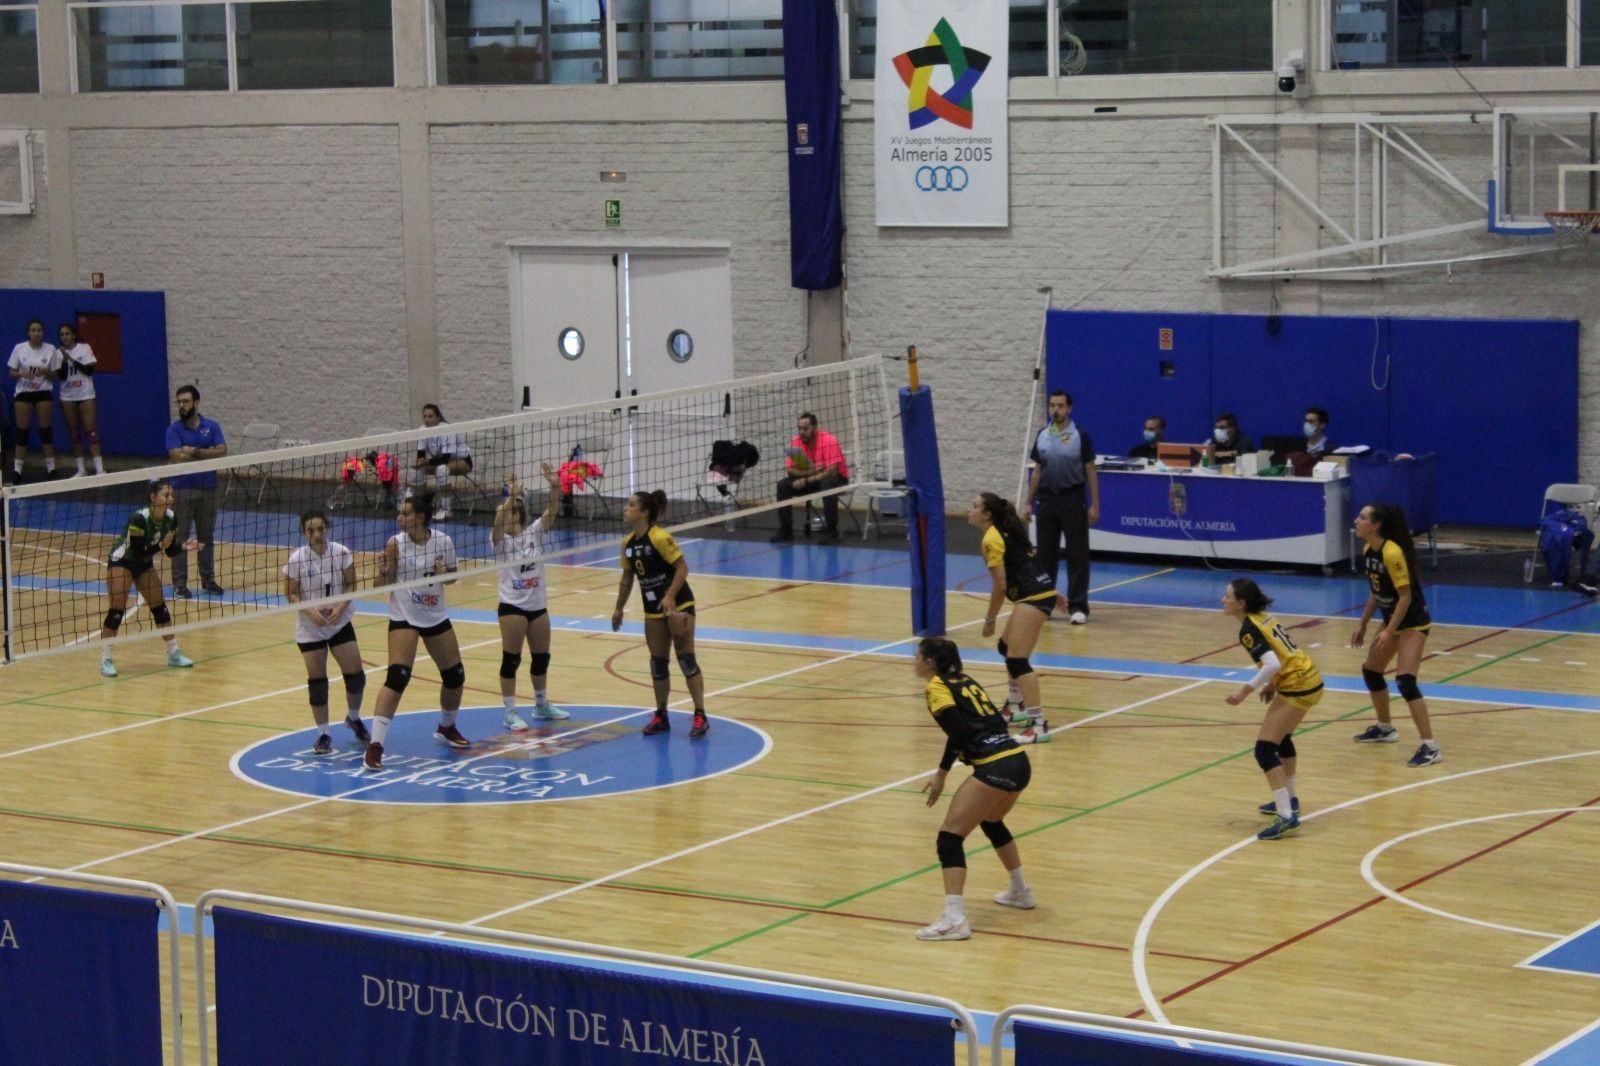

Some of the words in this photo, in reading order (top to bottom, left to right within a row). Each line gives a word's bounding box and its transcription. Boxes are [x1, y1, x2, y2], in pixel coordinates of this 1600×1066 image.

[890, 136, 902, 145] XV
[905, 136, 931, 147] Juegos
[934, 136, 992, 145] Mediterráneos
[890, 146, 948, 162] Almería
[954, 146, 993, 162] 2005
[1121, 516, 1178, 528] DIPUTACIÓN
[1180, 520, 1192, 529] DE
[1195, 521, 1236, 532] ALMERÍA
[961, 684, 997, 717] 13
[255, 757, 334, 773] DE
[361, 973, 557, 1038] DIPUTACIÓN
[566, 1009, 610, 1047] DE
[619, 1018, 766, 1066] ALMERÍA
